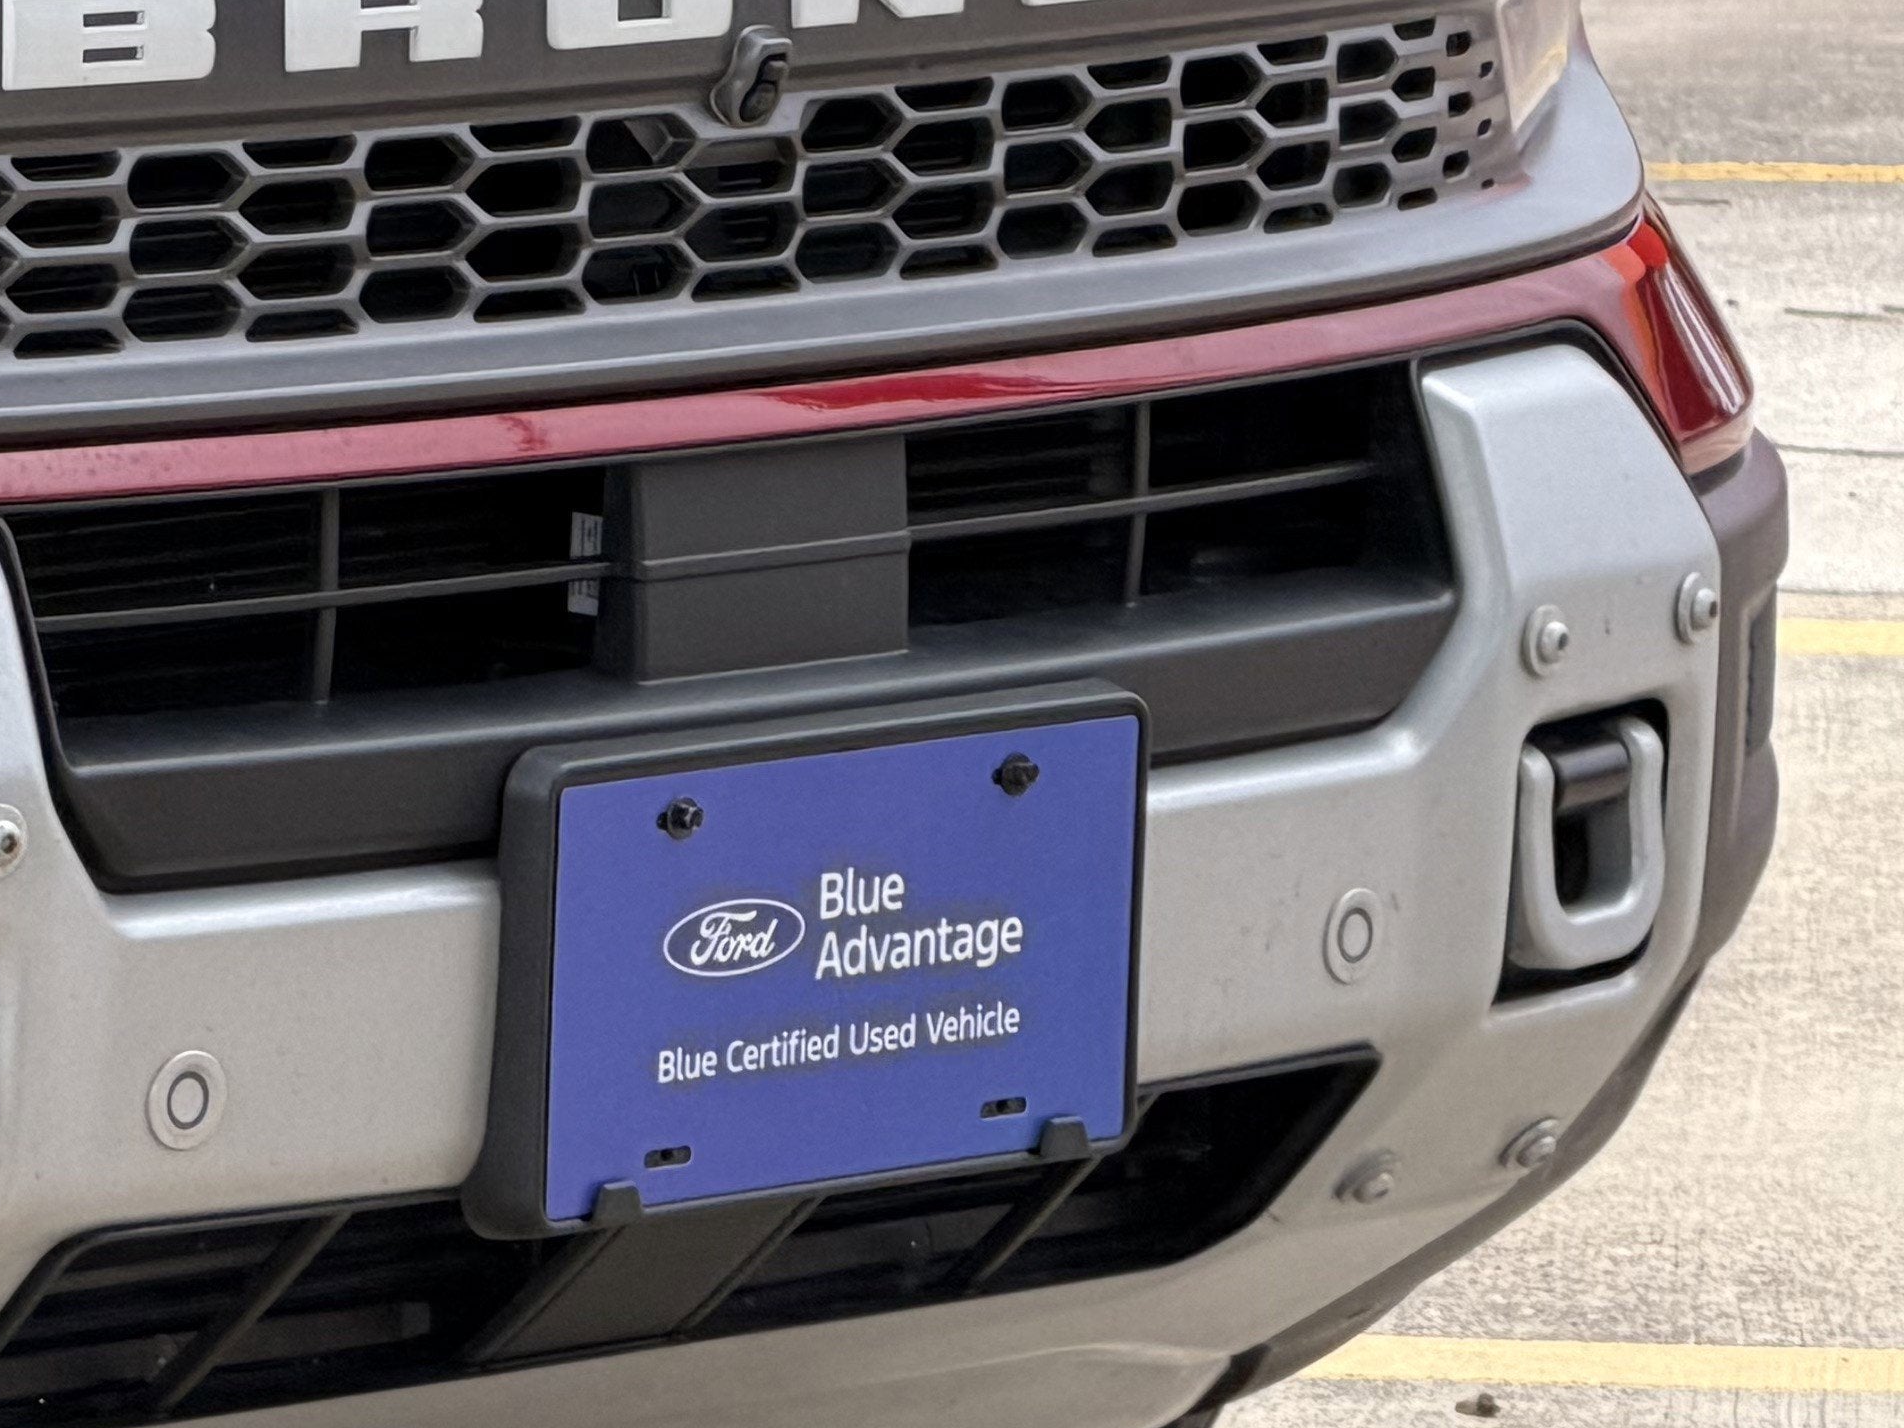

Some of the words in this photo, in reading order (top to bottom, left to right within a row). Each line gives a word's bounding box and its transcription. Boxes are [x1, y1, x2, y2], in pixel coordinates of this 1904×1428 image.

[819, 866, 906, 921] Blue
[687, 907, 781, 968] Ford
[814, 916, 1024, 981] Advantage
[657, 1046, 718, 1085] Blue
[726, 1023, 840, 1074] Certified
[849, 1012, 917, 1057] Used
[925, 1000, 1021, 1046] Vehicle
